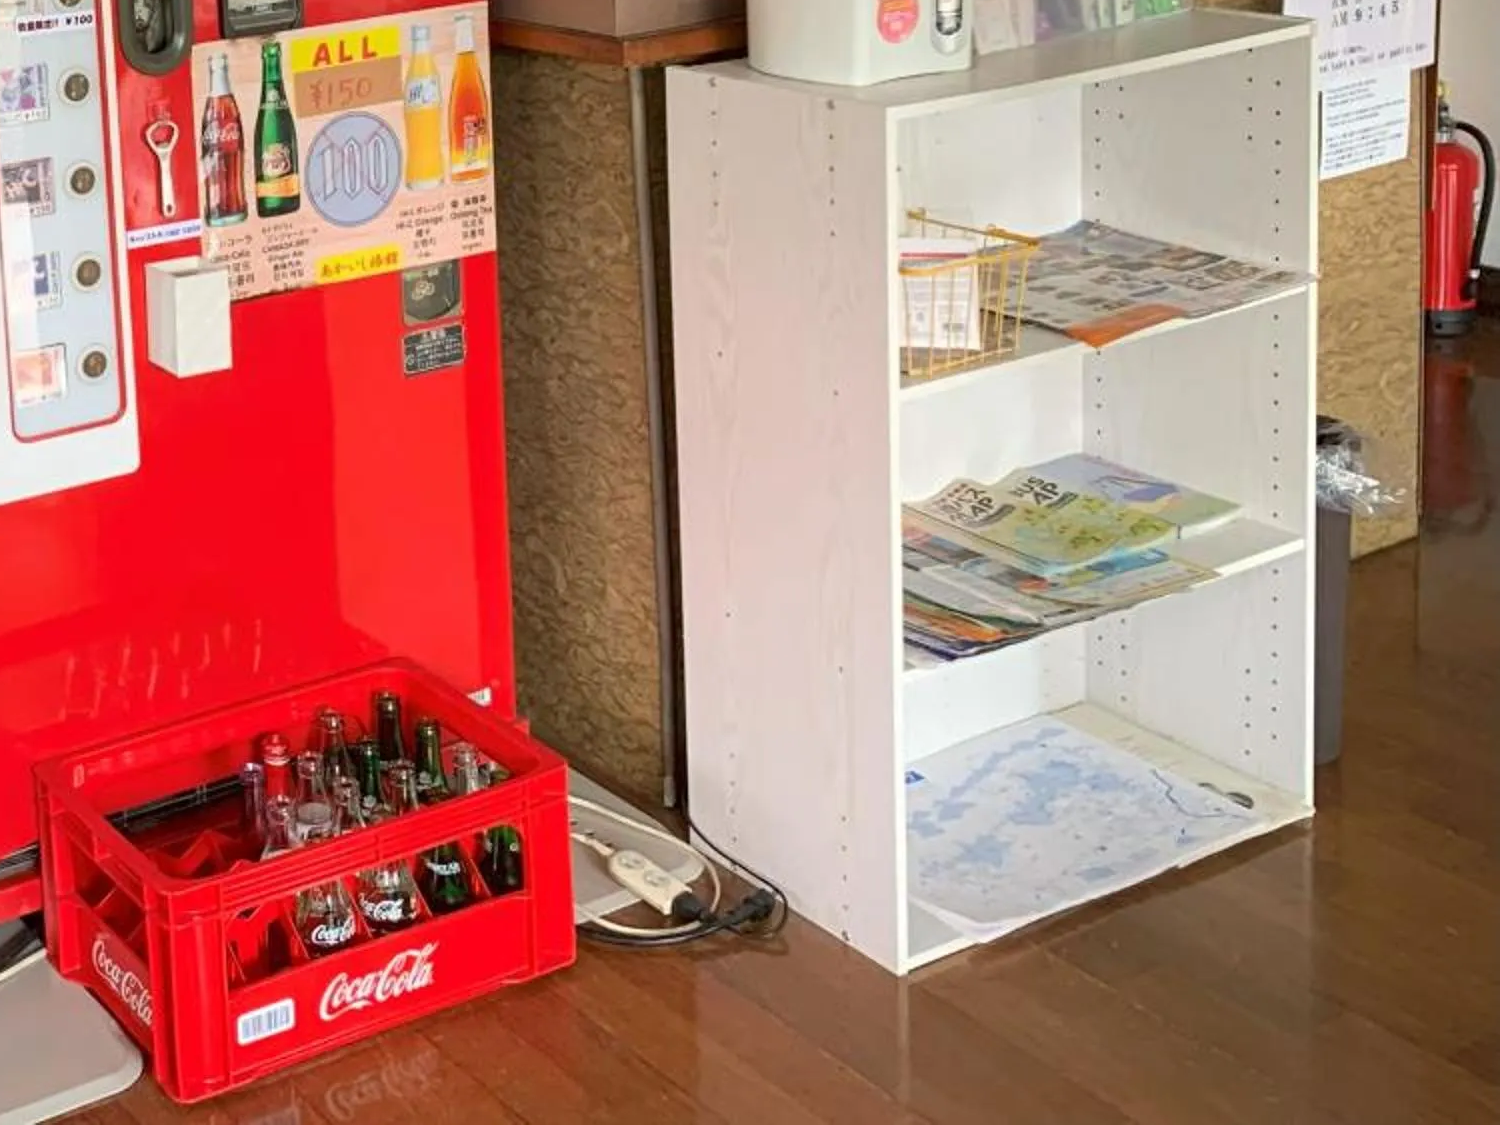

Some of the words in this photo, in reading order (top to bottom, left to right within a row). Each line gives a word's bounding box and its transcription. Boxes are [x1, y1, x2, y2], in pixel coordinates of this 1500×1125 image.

[312, 36, 378, 68] ALL
[309, 76, 373, 111] ¥150
[319, 941, 440, 1022] Coca-Cola
